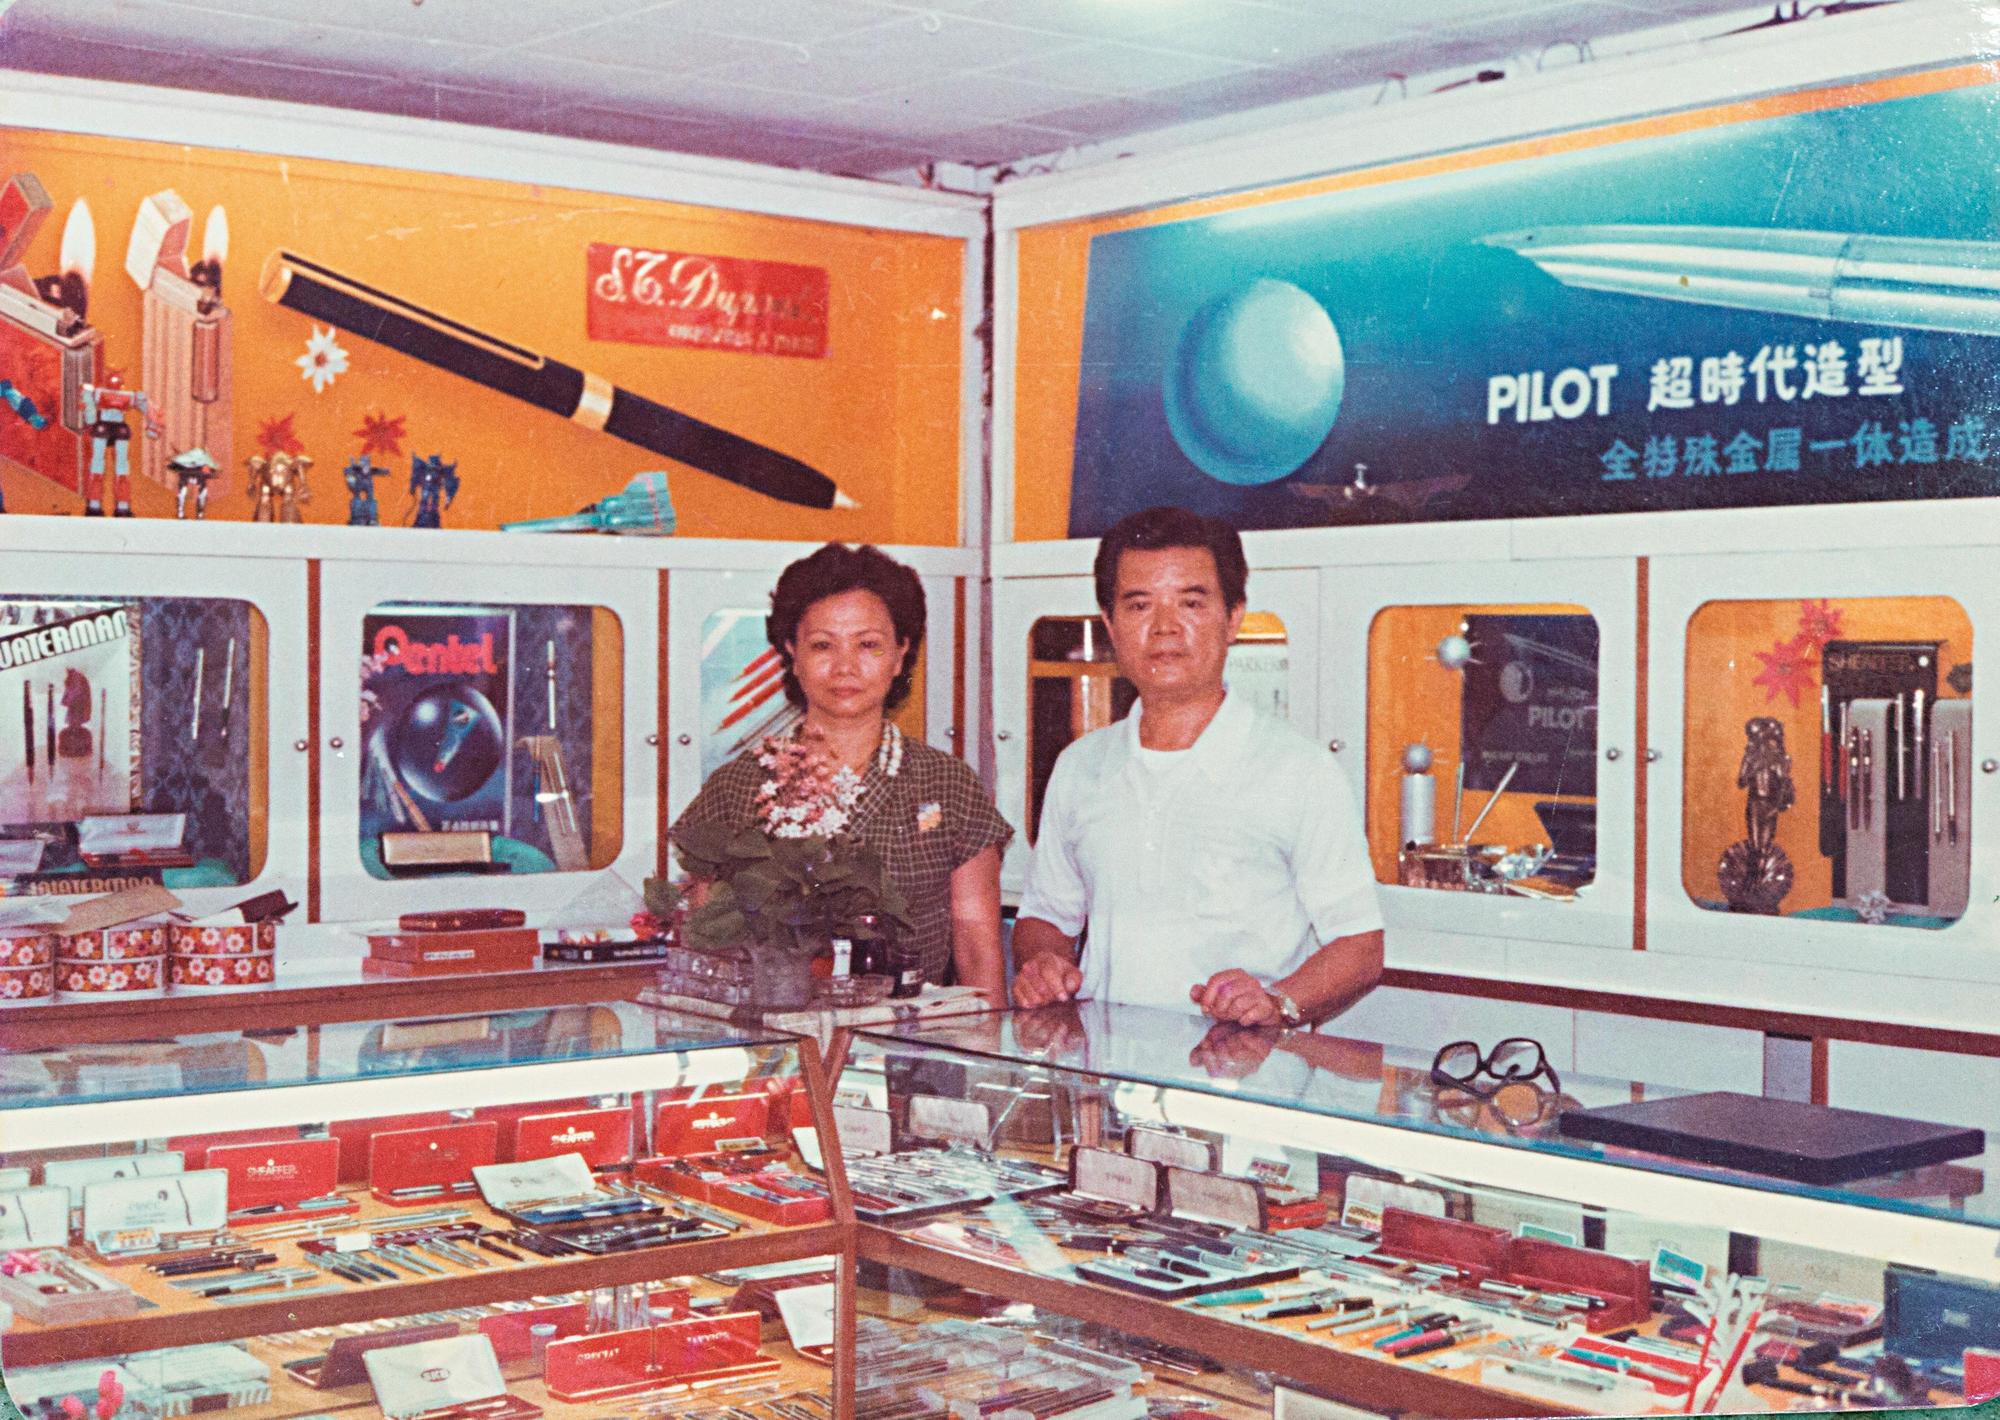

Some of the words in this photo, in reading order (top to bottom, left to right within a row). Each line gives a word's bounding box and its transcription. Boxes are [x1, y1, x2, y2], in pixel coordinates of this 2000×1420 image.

[1486, 363, 1620, 425] PILOT
[1646, 335, 1905, 412] 超時代造型
[373, 624, 498, 675] Pentel
[1527, 703, 1588, 730] PILOT
